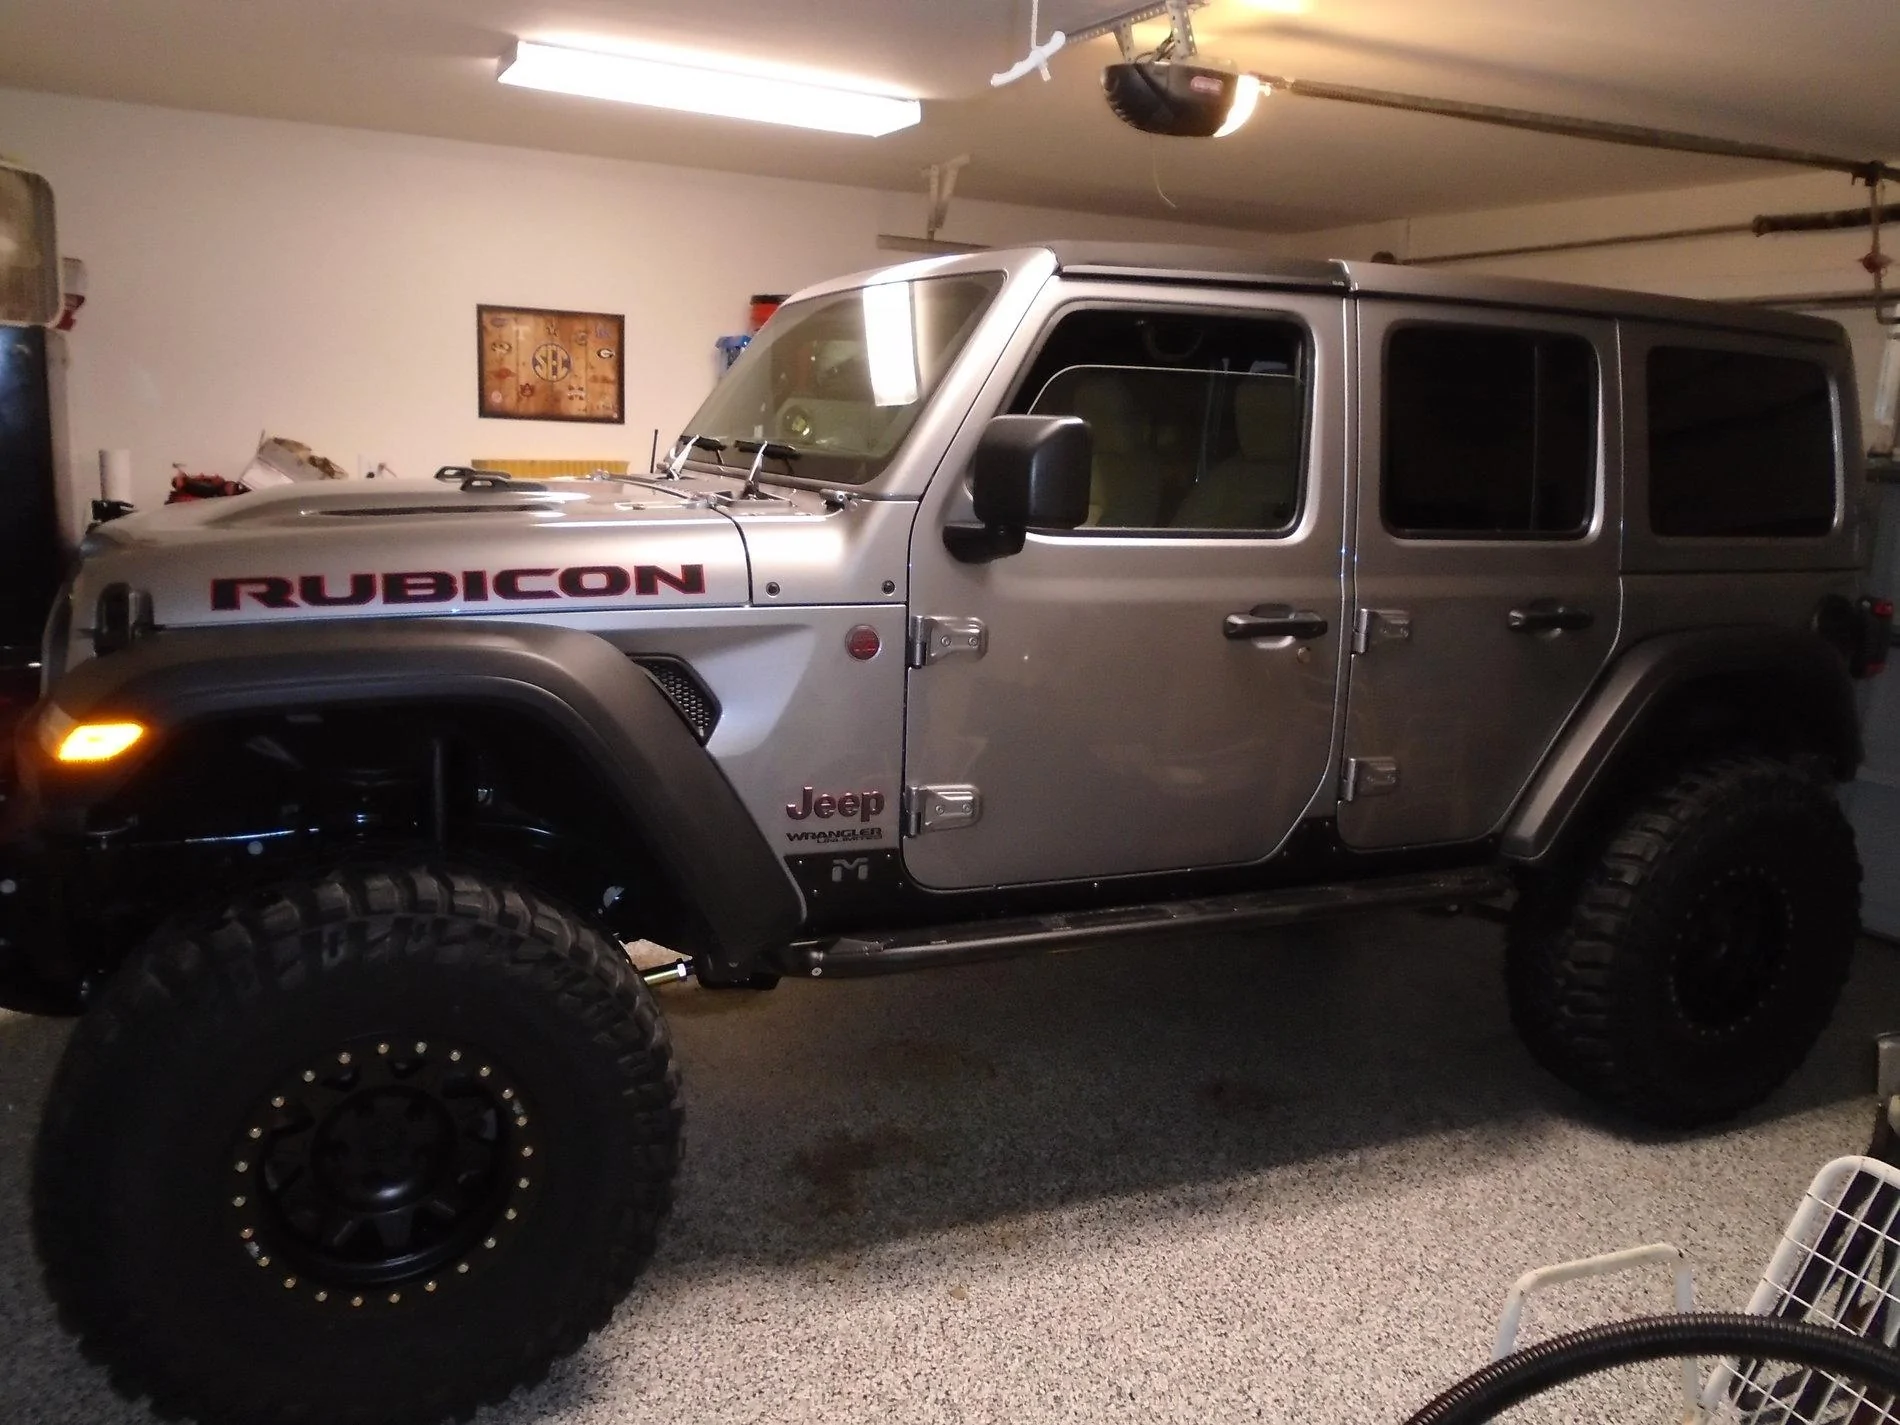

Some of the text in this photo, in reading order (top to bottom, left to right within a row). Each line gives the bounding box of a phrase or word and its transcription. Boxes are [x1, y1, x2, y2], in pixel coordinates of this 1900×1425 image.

[211, 564, 706, 611] RUBICON
[786, 786, 885, 822] Jeep
[785, 827, 883, 842] WRANGLER
